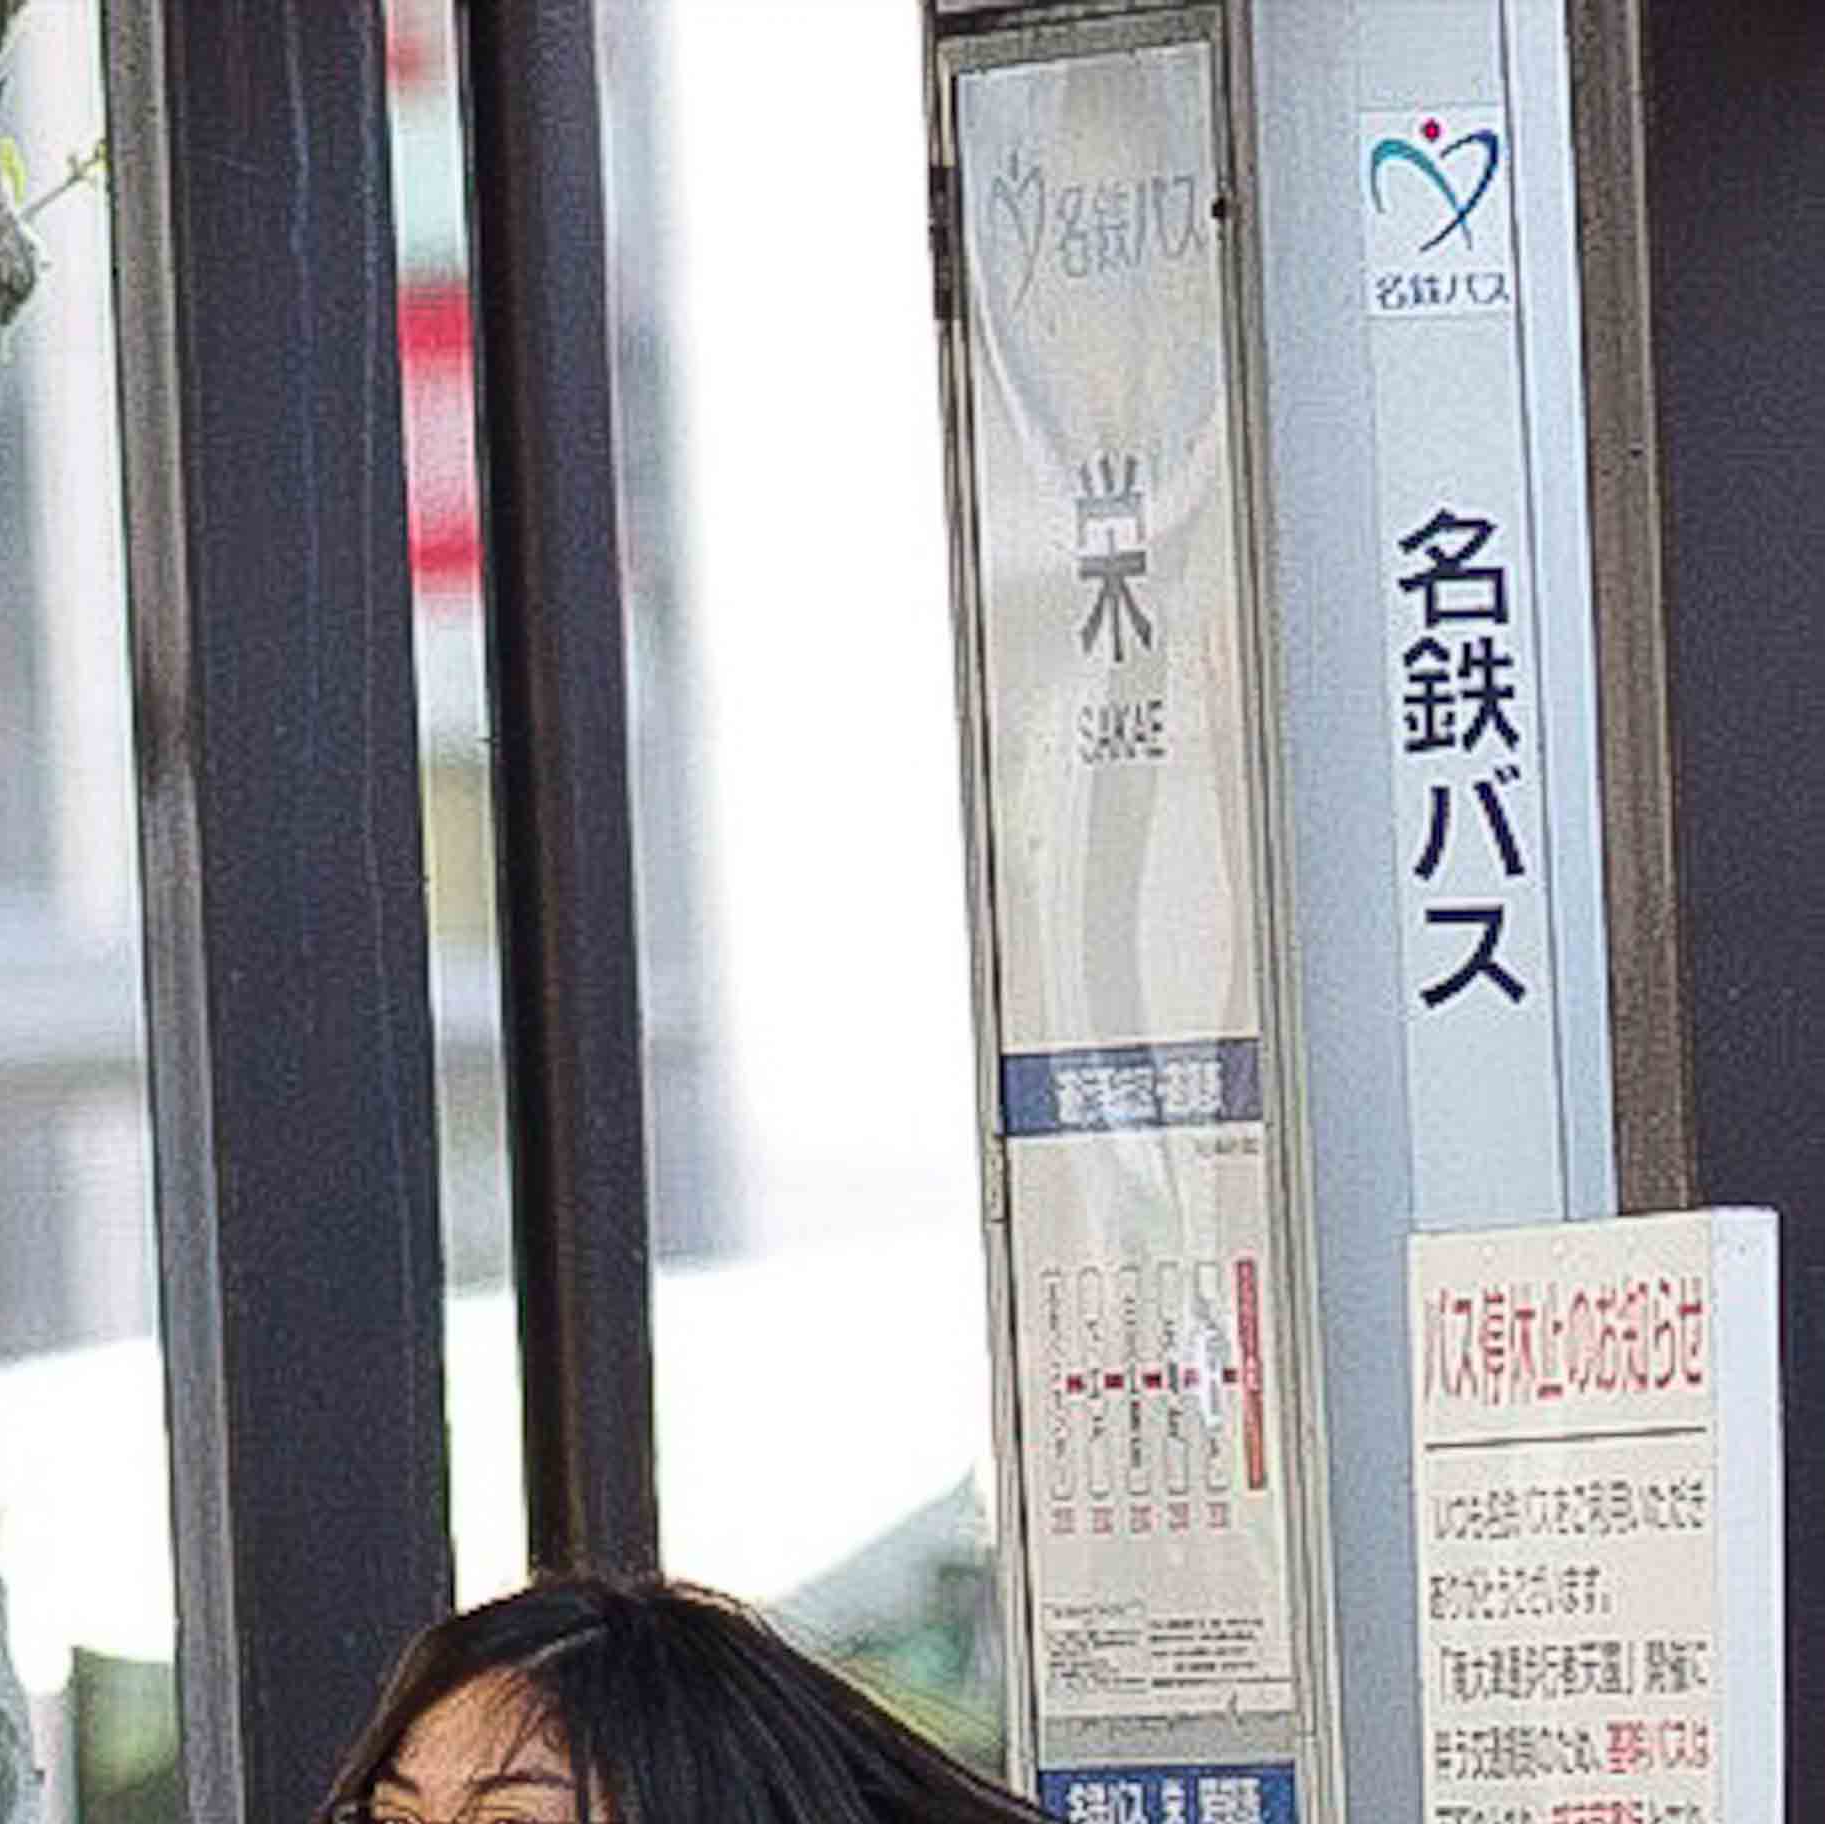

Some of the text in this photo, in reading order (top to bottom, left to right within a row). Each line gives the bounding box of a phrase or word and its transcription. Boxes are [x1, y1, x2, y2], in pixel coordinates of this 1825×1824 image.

[1376, 272, 1511, 310] 名鉄バス
[1077, 452, 1153, 663] 栄
[1078, 698, 1166, 763] SAKAE
[1398, 507, 1525, 1008] 名鉄バス
